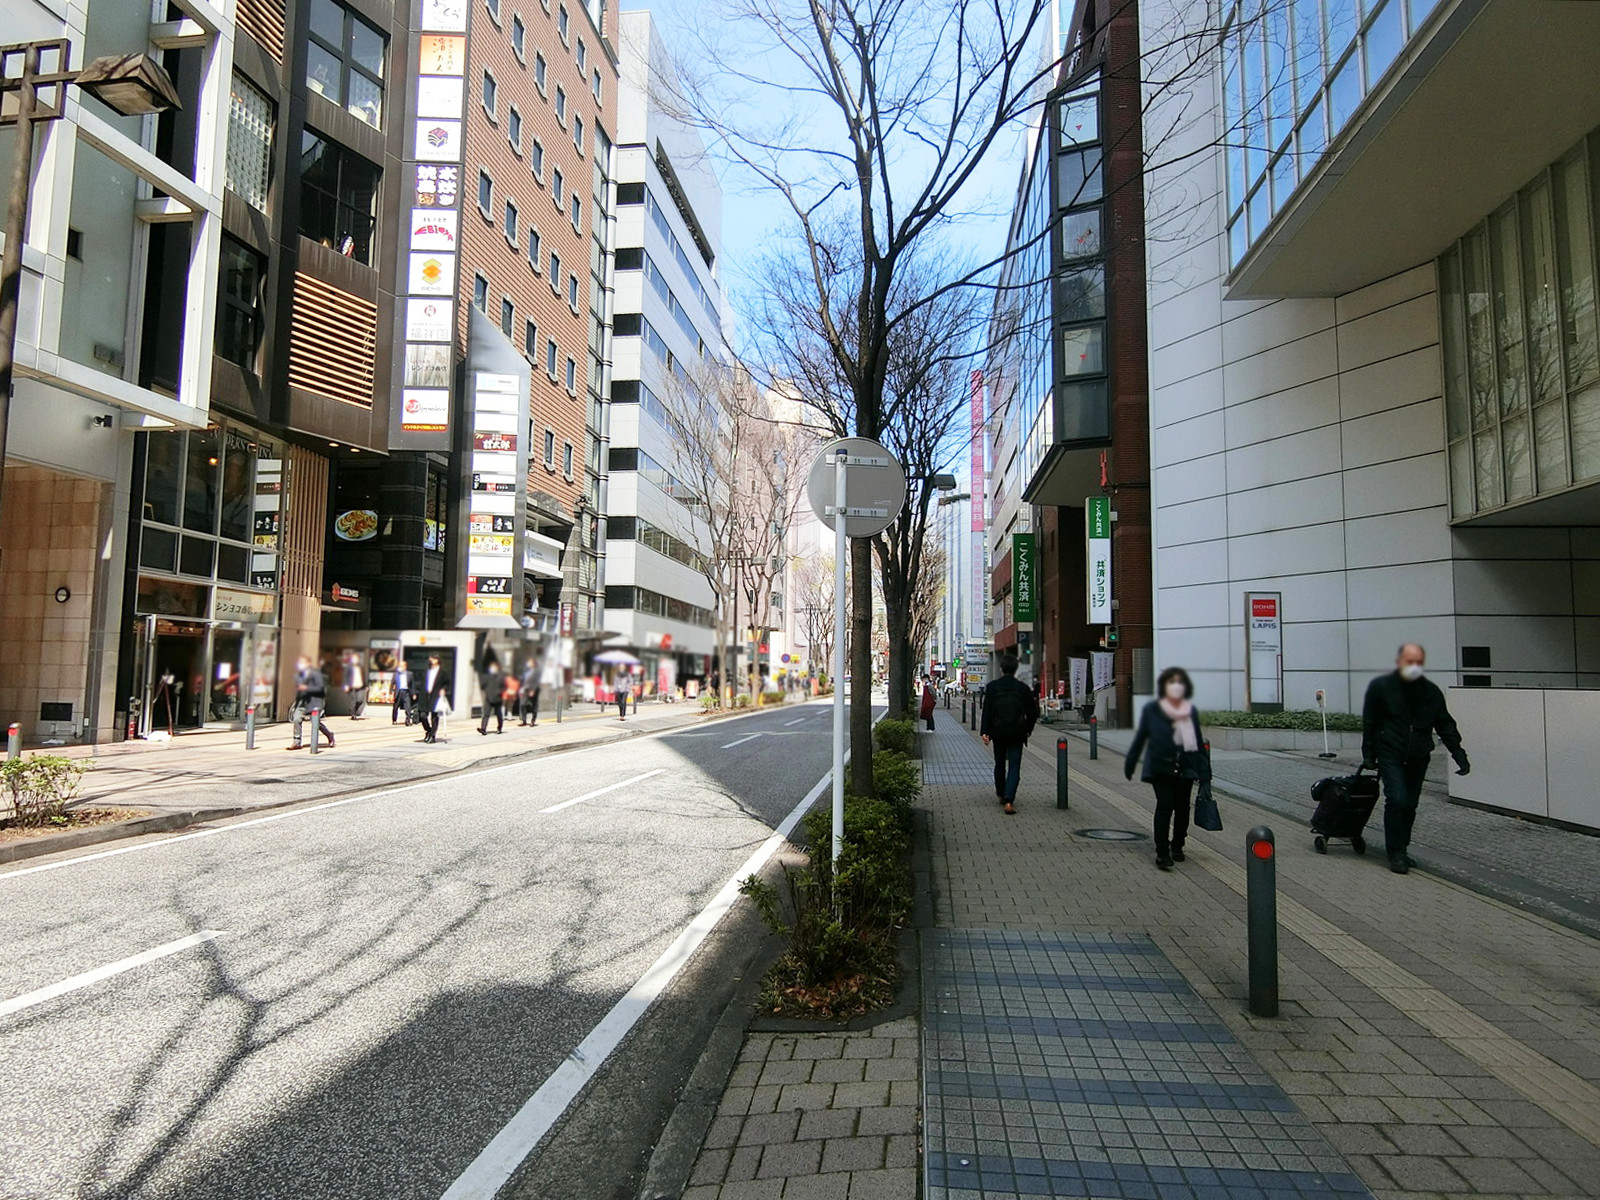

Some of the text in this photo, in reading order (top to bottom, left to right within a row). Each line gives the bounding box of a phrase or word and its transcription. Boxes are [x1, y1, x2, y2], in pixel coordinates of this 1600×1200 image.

[1018, 543, 1029, 602] こくみん共済
[1096, 560, 1106, 608] 共済ショップ
